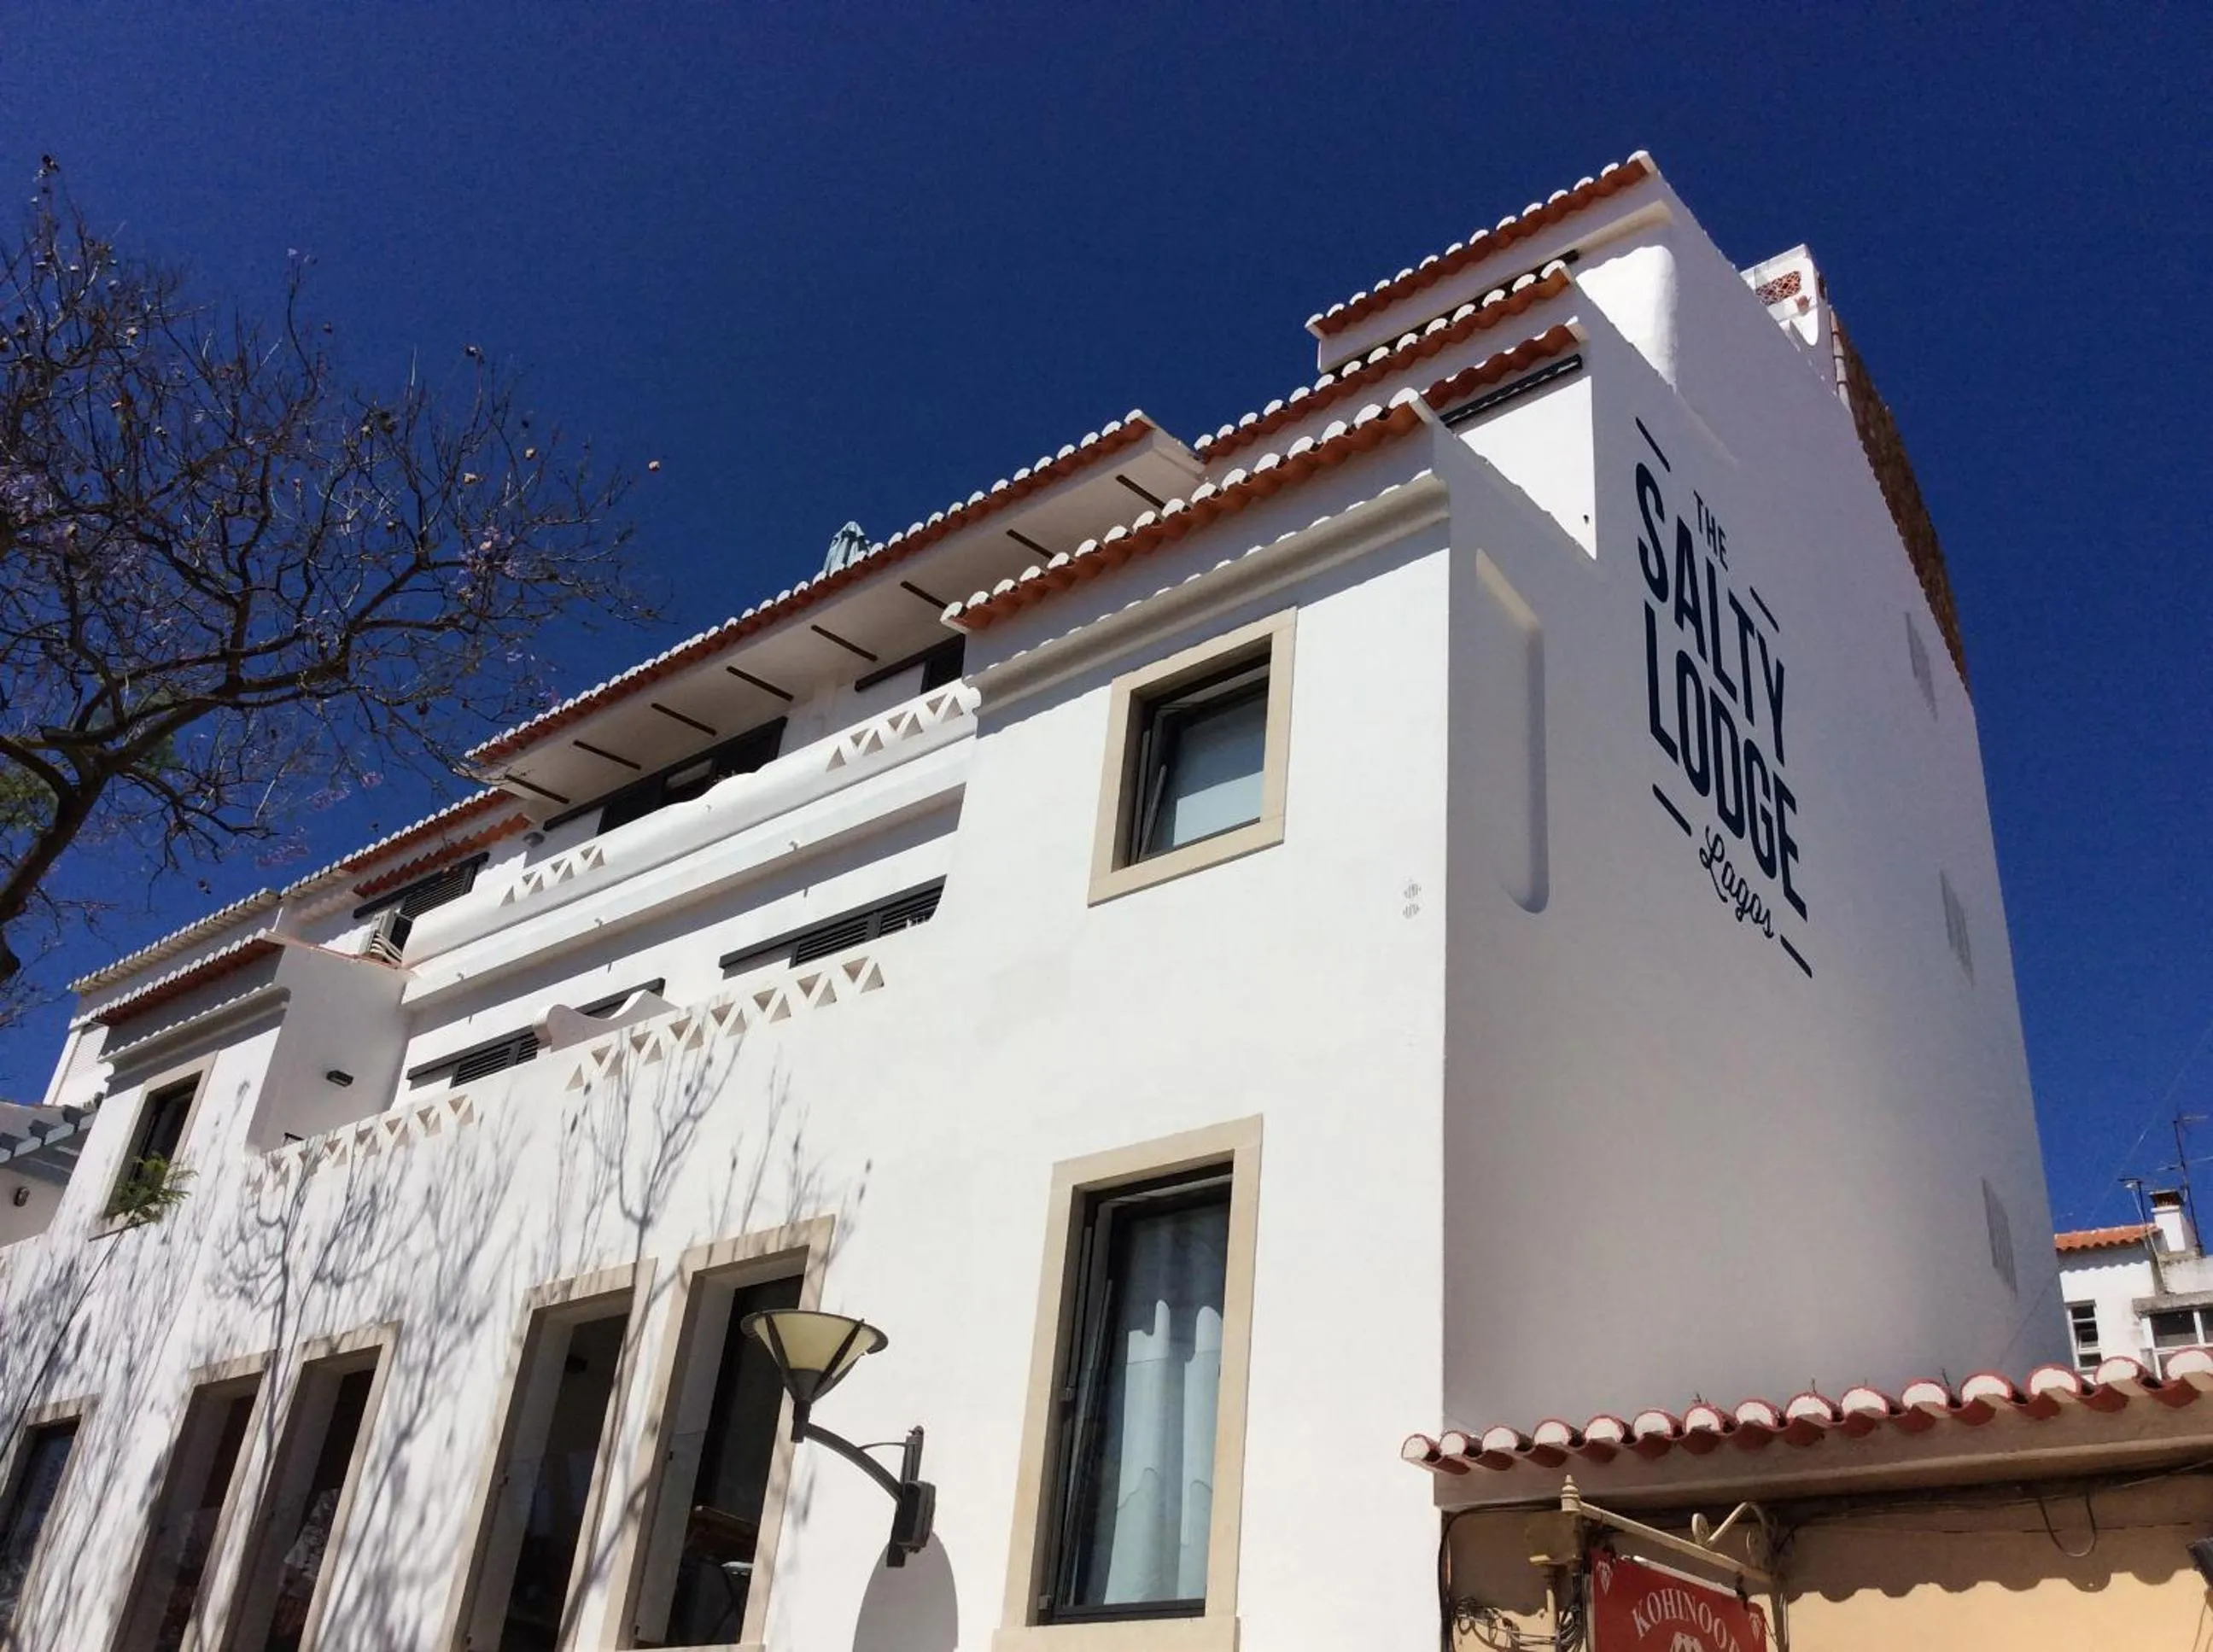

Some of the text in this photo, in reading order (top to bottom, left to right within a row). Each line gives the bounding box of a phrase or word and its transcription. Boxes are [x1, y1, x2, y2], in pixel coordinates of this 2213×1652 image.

[1635, 462, 1785, 768] SALTY
[1693, 488, 1729, 573] THE
[1644, 599, 1807, 923] LODGE
[1699, 825, 1776, 939] Lagos
